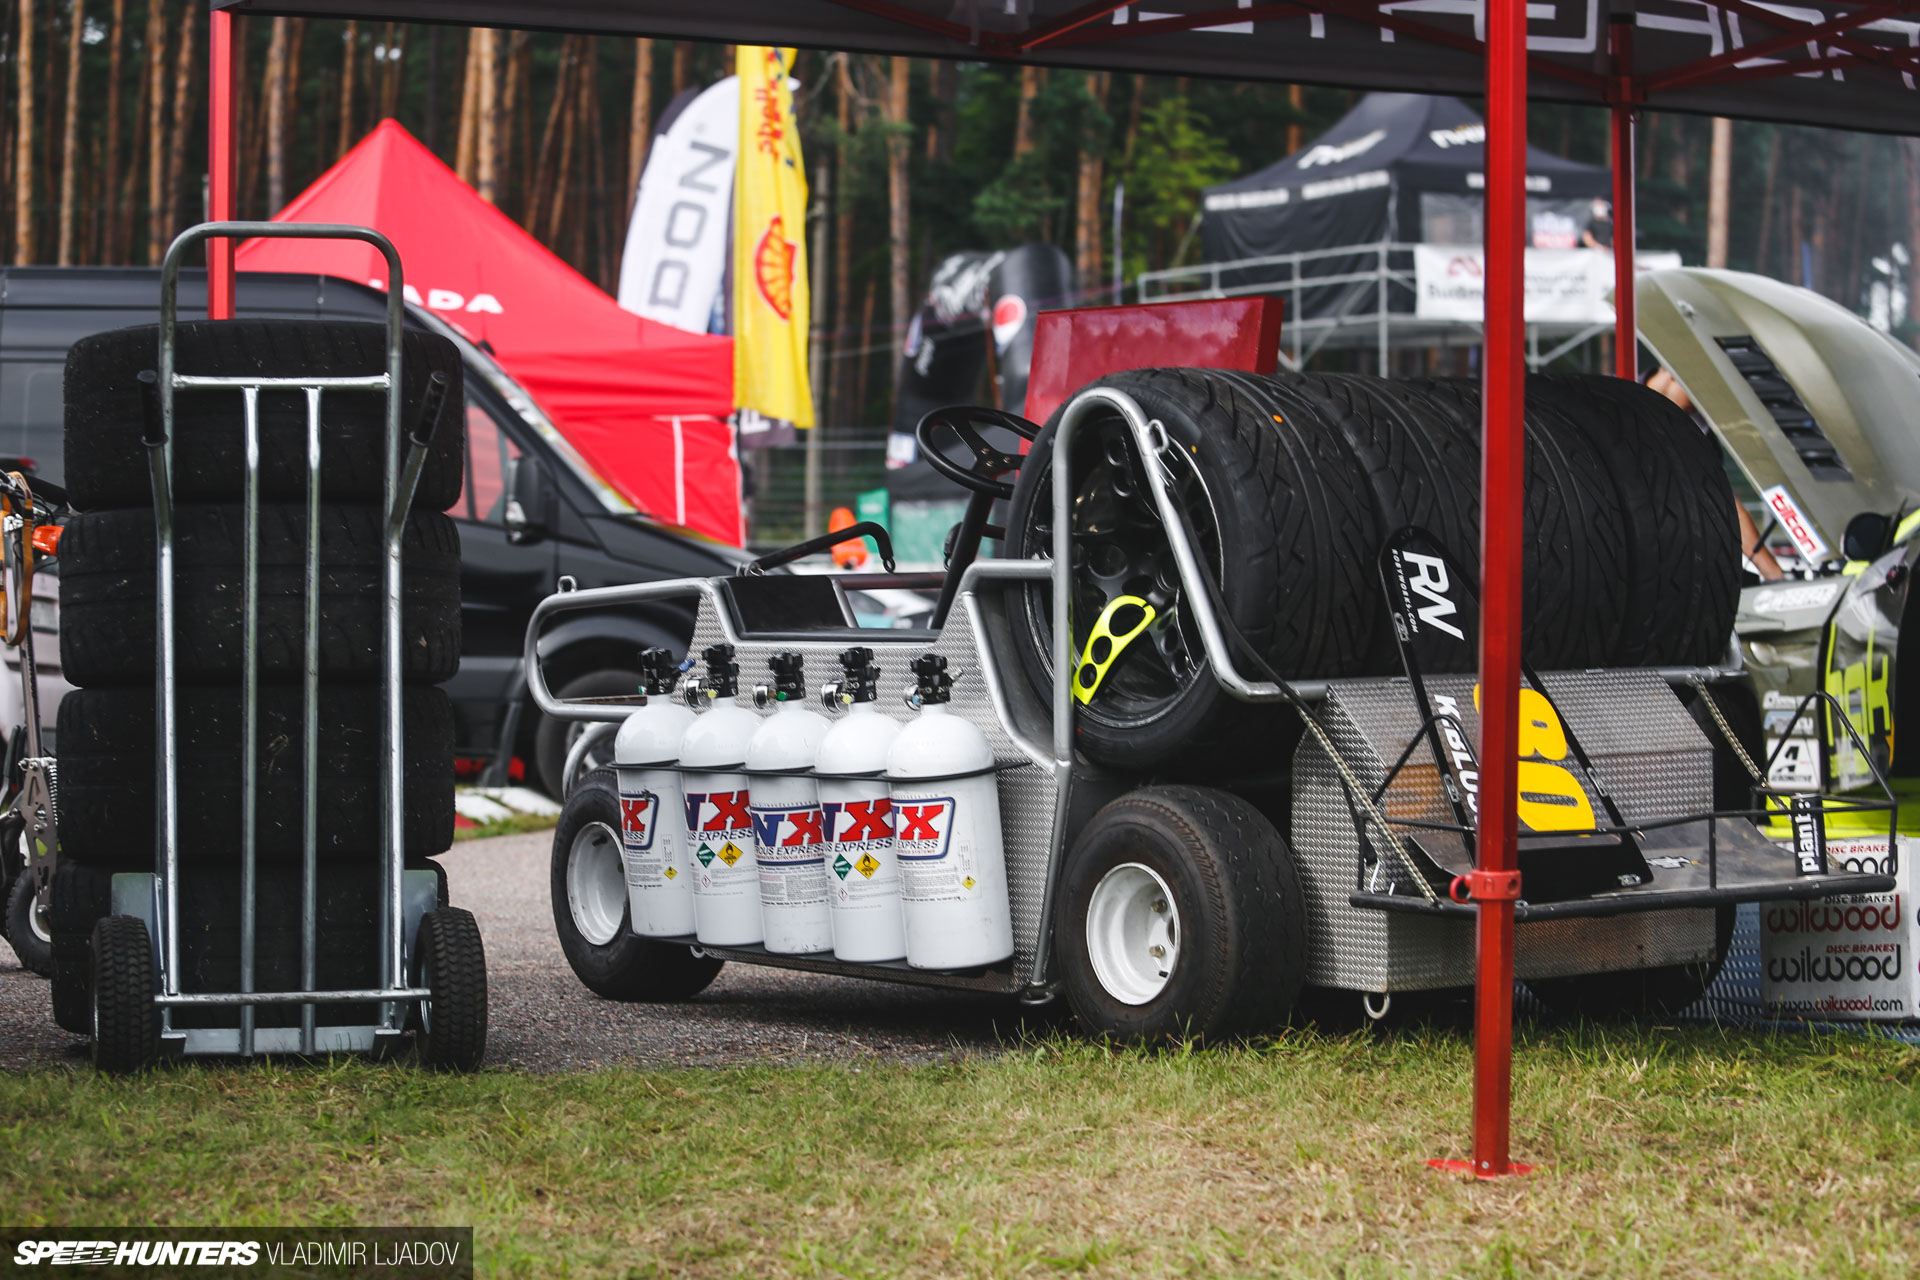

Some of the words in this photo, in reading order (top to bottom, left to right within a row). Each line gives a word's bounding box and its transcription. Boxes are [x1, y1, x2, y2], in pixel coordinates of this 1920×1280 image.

[698, 827, 754, 842] EXPRESS
[751, 810, 823, 847] NX
[834, 837, 893, 854] EXPRESS
[1849, 843, 1890, 854] BRAKE
[1824, 895, 1850, 904] DISC
[1851, 894, 1895, 903] BRAKES
[1766, 893, 1901, 933] wilwood
[1825, 944, 1850, 954] DISC
[1851, 943, 1896, 953] BRAKES
[1767, 943, 1902, 983] wilwood
[1768, 994, 1904, 1013] www.wilwood.com
